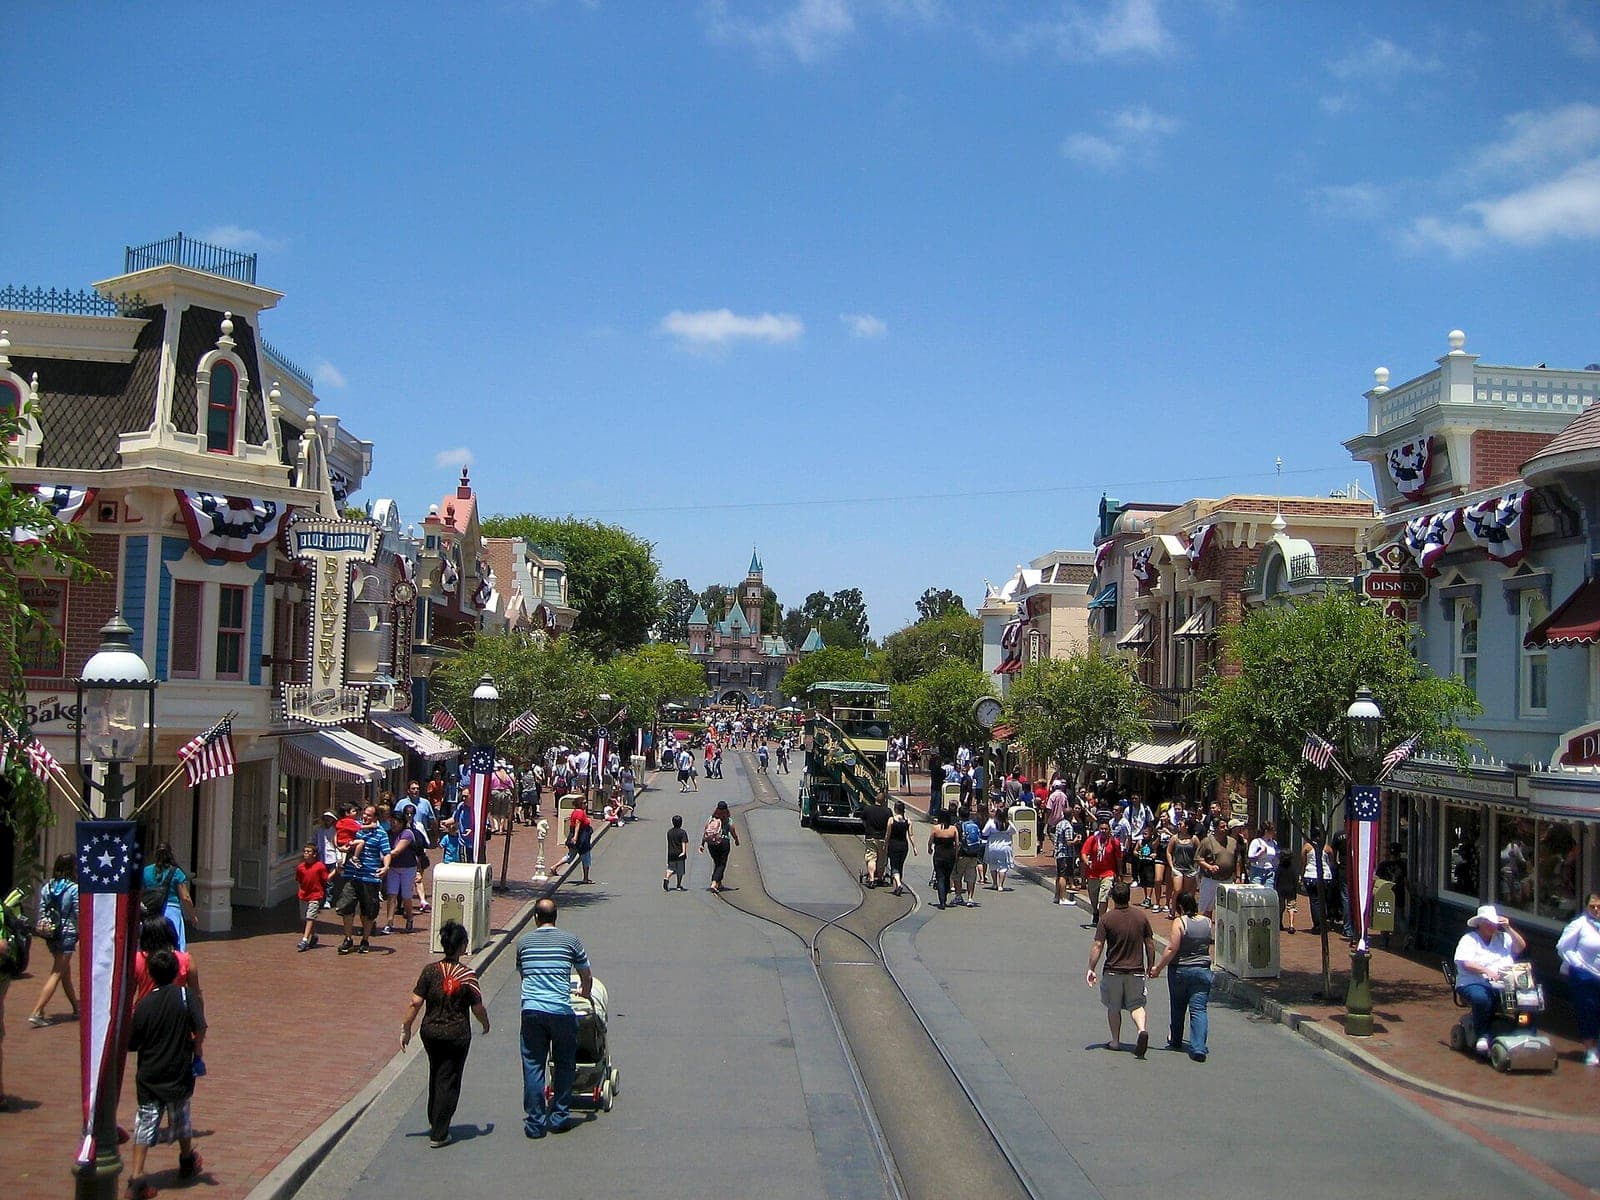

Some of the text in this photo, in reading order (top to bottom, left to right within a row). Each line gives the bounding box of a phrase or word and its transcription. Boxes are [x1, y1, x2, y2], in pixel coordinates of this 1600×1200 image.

[300, 534, 365, 548] BLUE RIBBON
[1372, 581, 1419, 592] DISNEY
[319, 555, 340, 681] BAKERY
[39, 695, 59, 709] FRESH
